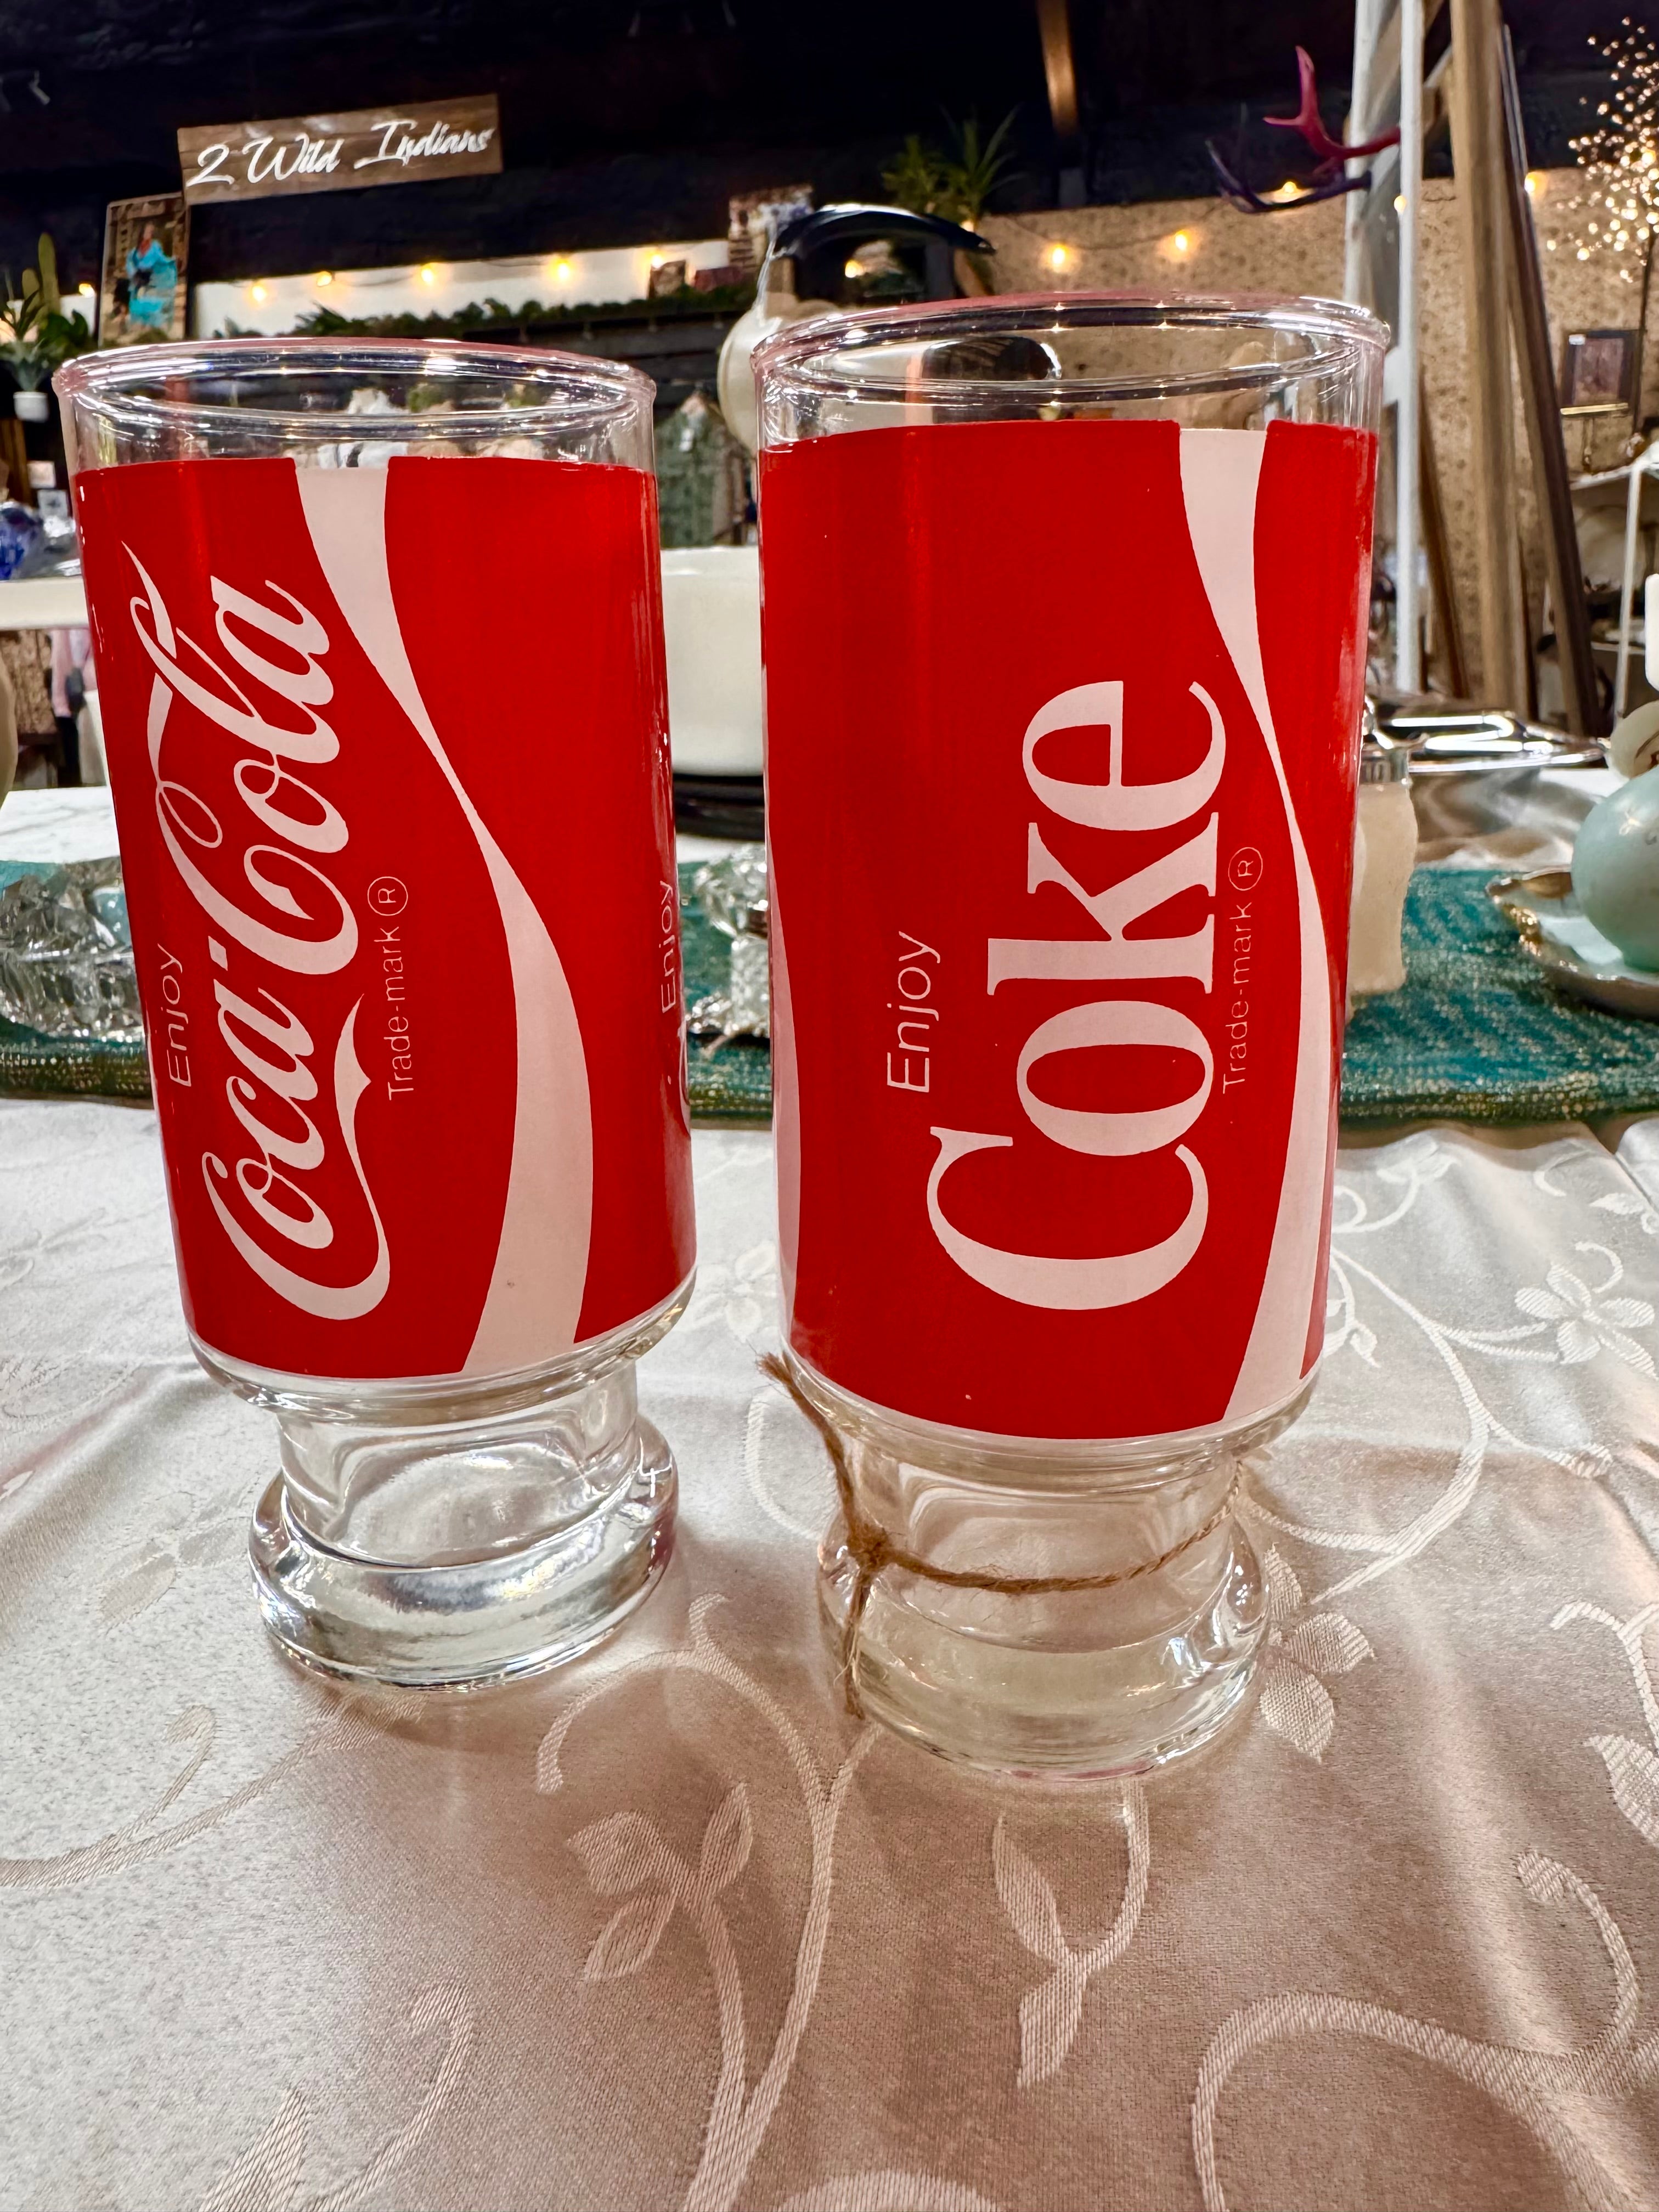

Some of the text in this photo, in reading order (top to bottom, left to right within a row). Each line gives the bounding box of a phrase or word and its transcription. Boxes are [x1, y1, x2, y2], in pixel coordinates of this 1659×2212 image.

[187, 119, 496, 187] 2 Wild Indians
[157, 944, 191, 1087] Enjoy
[373, 926, 414, 1101] Trade-mark
[659, 880, 676, 1013] Enjoy
[887, 930, 940, 1094] Enjoy
[927, 680, 1226, 1310] Coke
[1222, 901, 1252, 1094] Trade-mark
